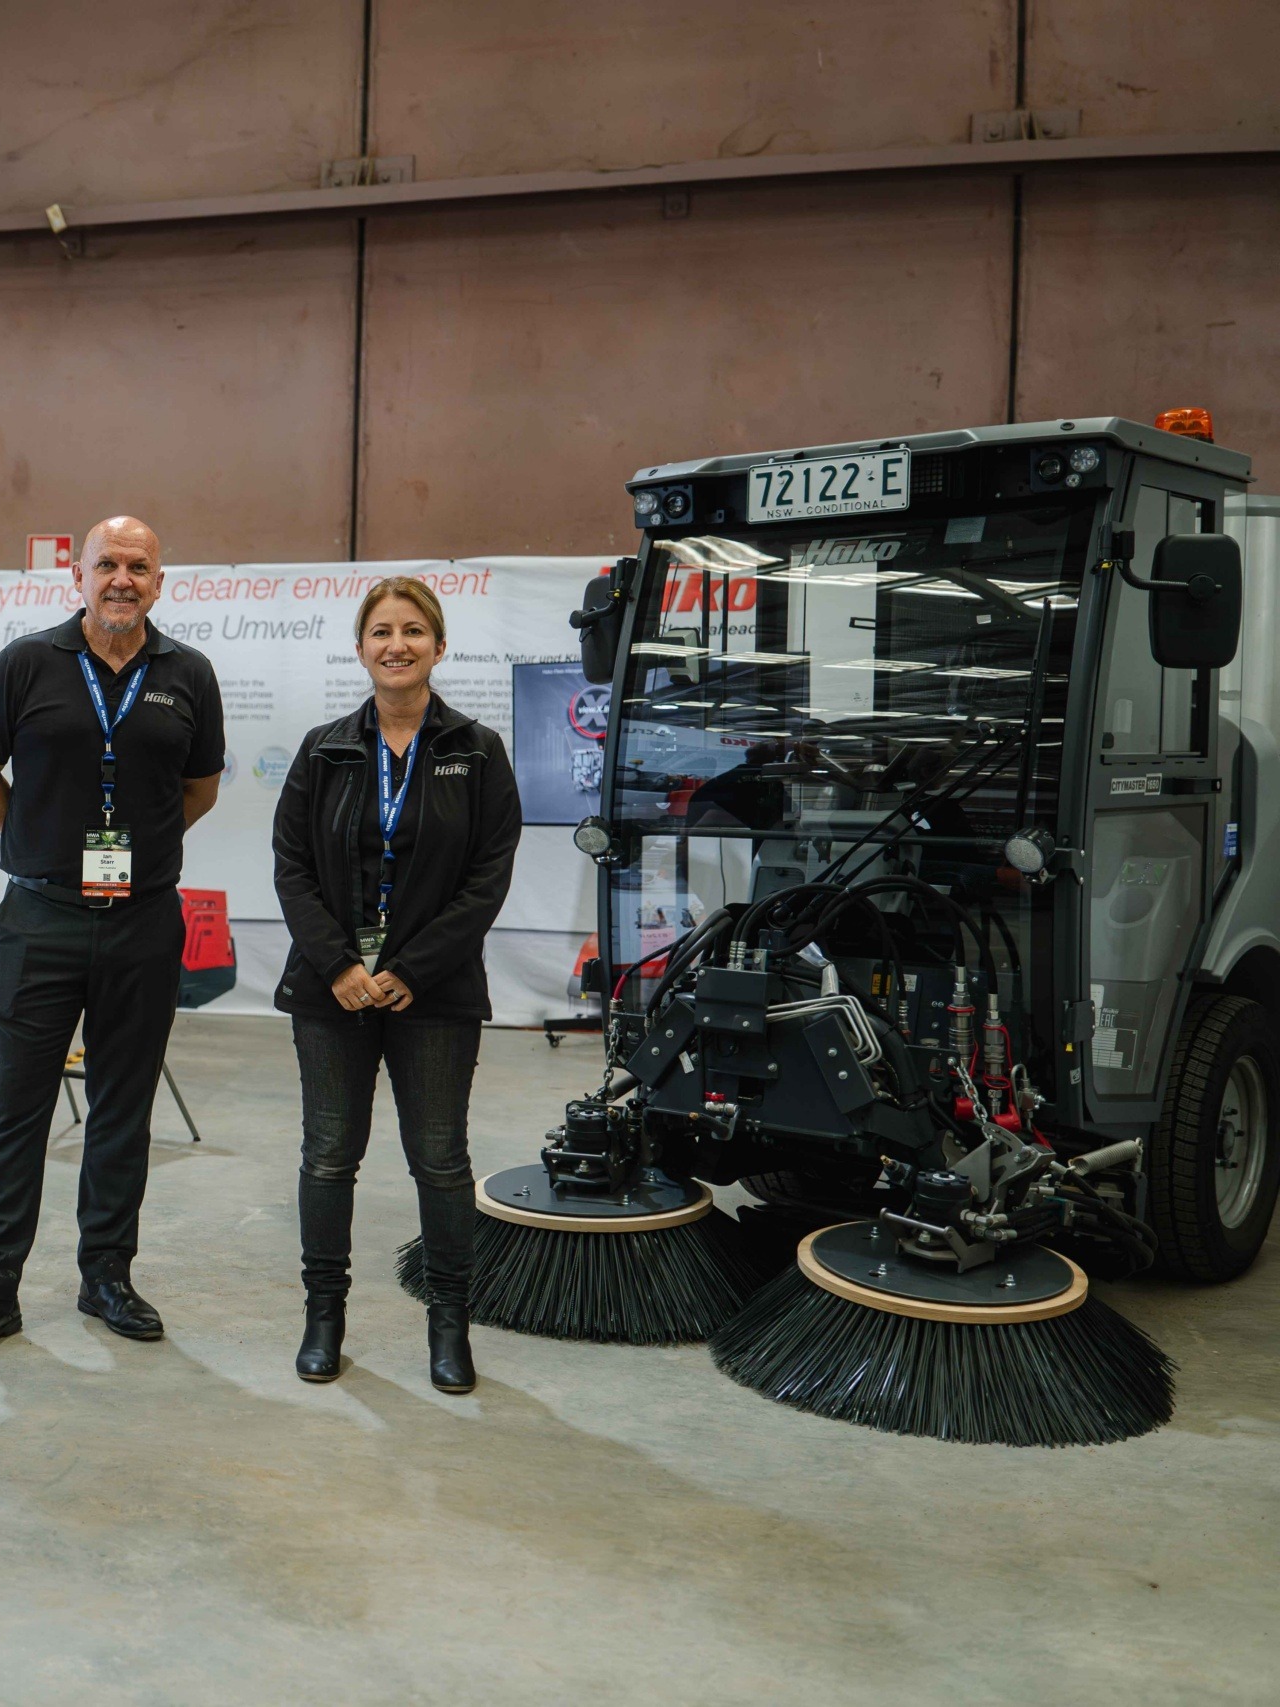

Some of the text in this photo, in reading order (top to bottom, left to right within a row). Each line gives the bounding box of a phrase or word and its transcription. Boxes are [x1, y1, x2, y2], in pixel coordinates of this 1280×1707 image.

[755, 457, 903, 508] 72122 E
[767, 507, 793, 518] NSW
[806, 500, 888, 515] CONDITIONAL
[800, 533, 907, 566] Hako
[171, 573, 285, 602] cleaner
[292, 567, 492, 600] envirment
[222, 614, 326, 641] Umwelt
[453, 652, 500, 665] Mensch,
[504, 652, 537, 664] Natur
[539, 653, 562, 664] und
[143, 692, 176, 706] Hako
[434, 763, 471, 776] Hako
[1111, 779, 1146, 791] CITYMASTER
